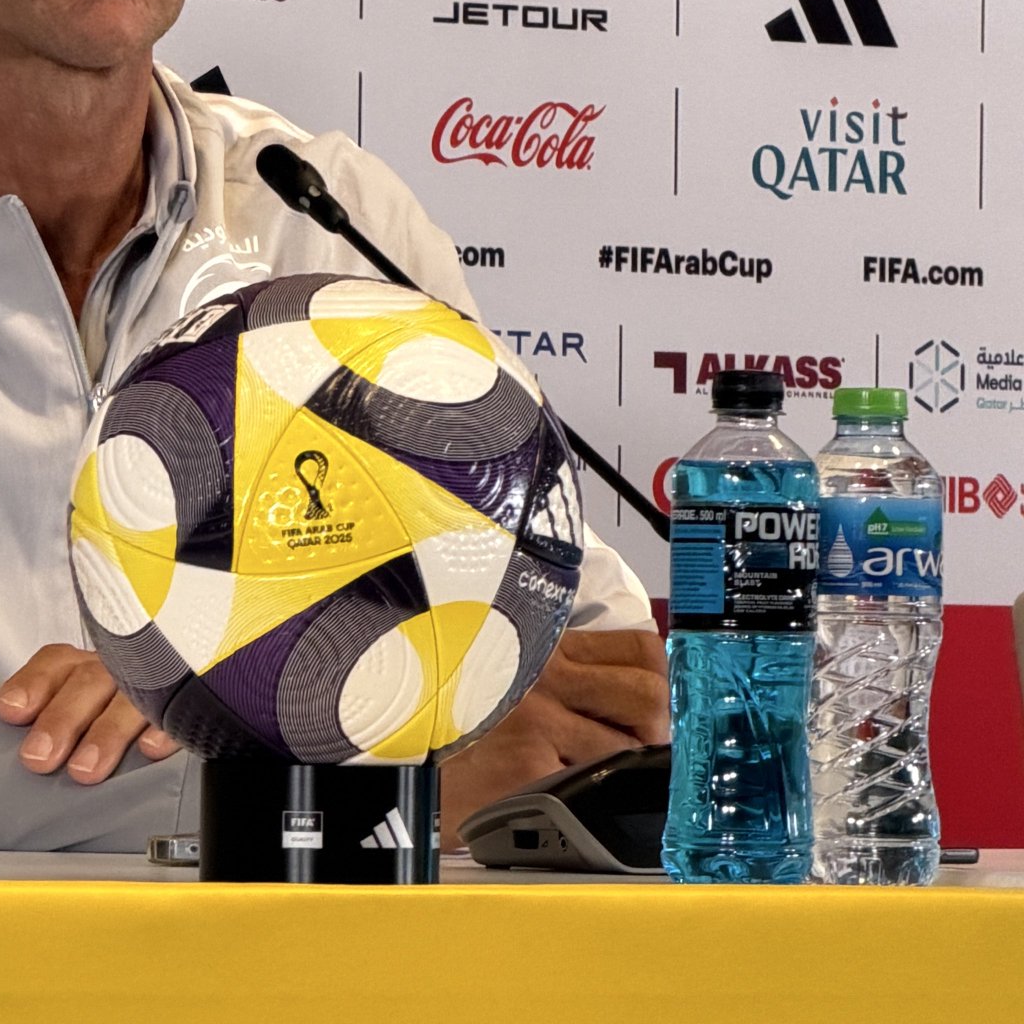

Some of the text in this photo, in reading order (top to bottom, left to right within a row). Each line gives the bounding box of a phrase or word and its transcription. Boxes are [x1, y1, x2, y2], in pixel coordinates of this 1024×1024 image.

[433, 1, 610, 34] JETOUR
[800, 96, 908, 146] visit
[752, 144, 907, 200] QATAR
[598, 245, 774, 285] #FIFArabCup
[863, 256, 985, 288] FIFA.com
[976, 372, 1022, 392] Media
[324, 533, 353, 545] 2025
[862, 546, 944, 578] arw
[290, 817, 315, 828] FIFA
